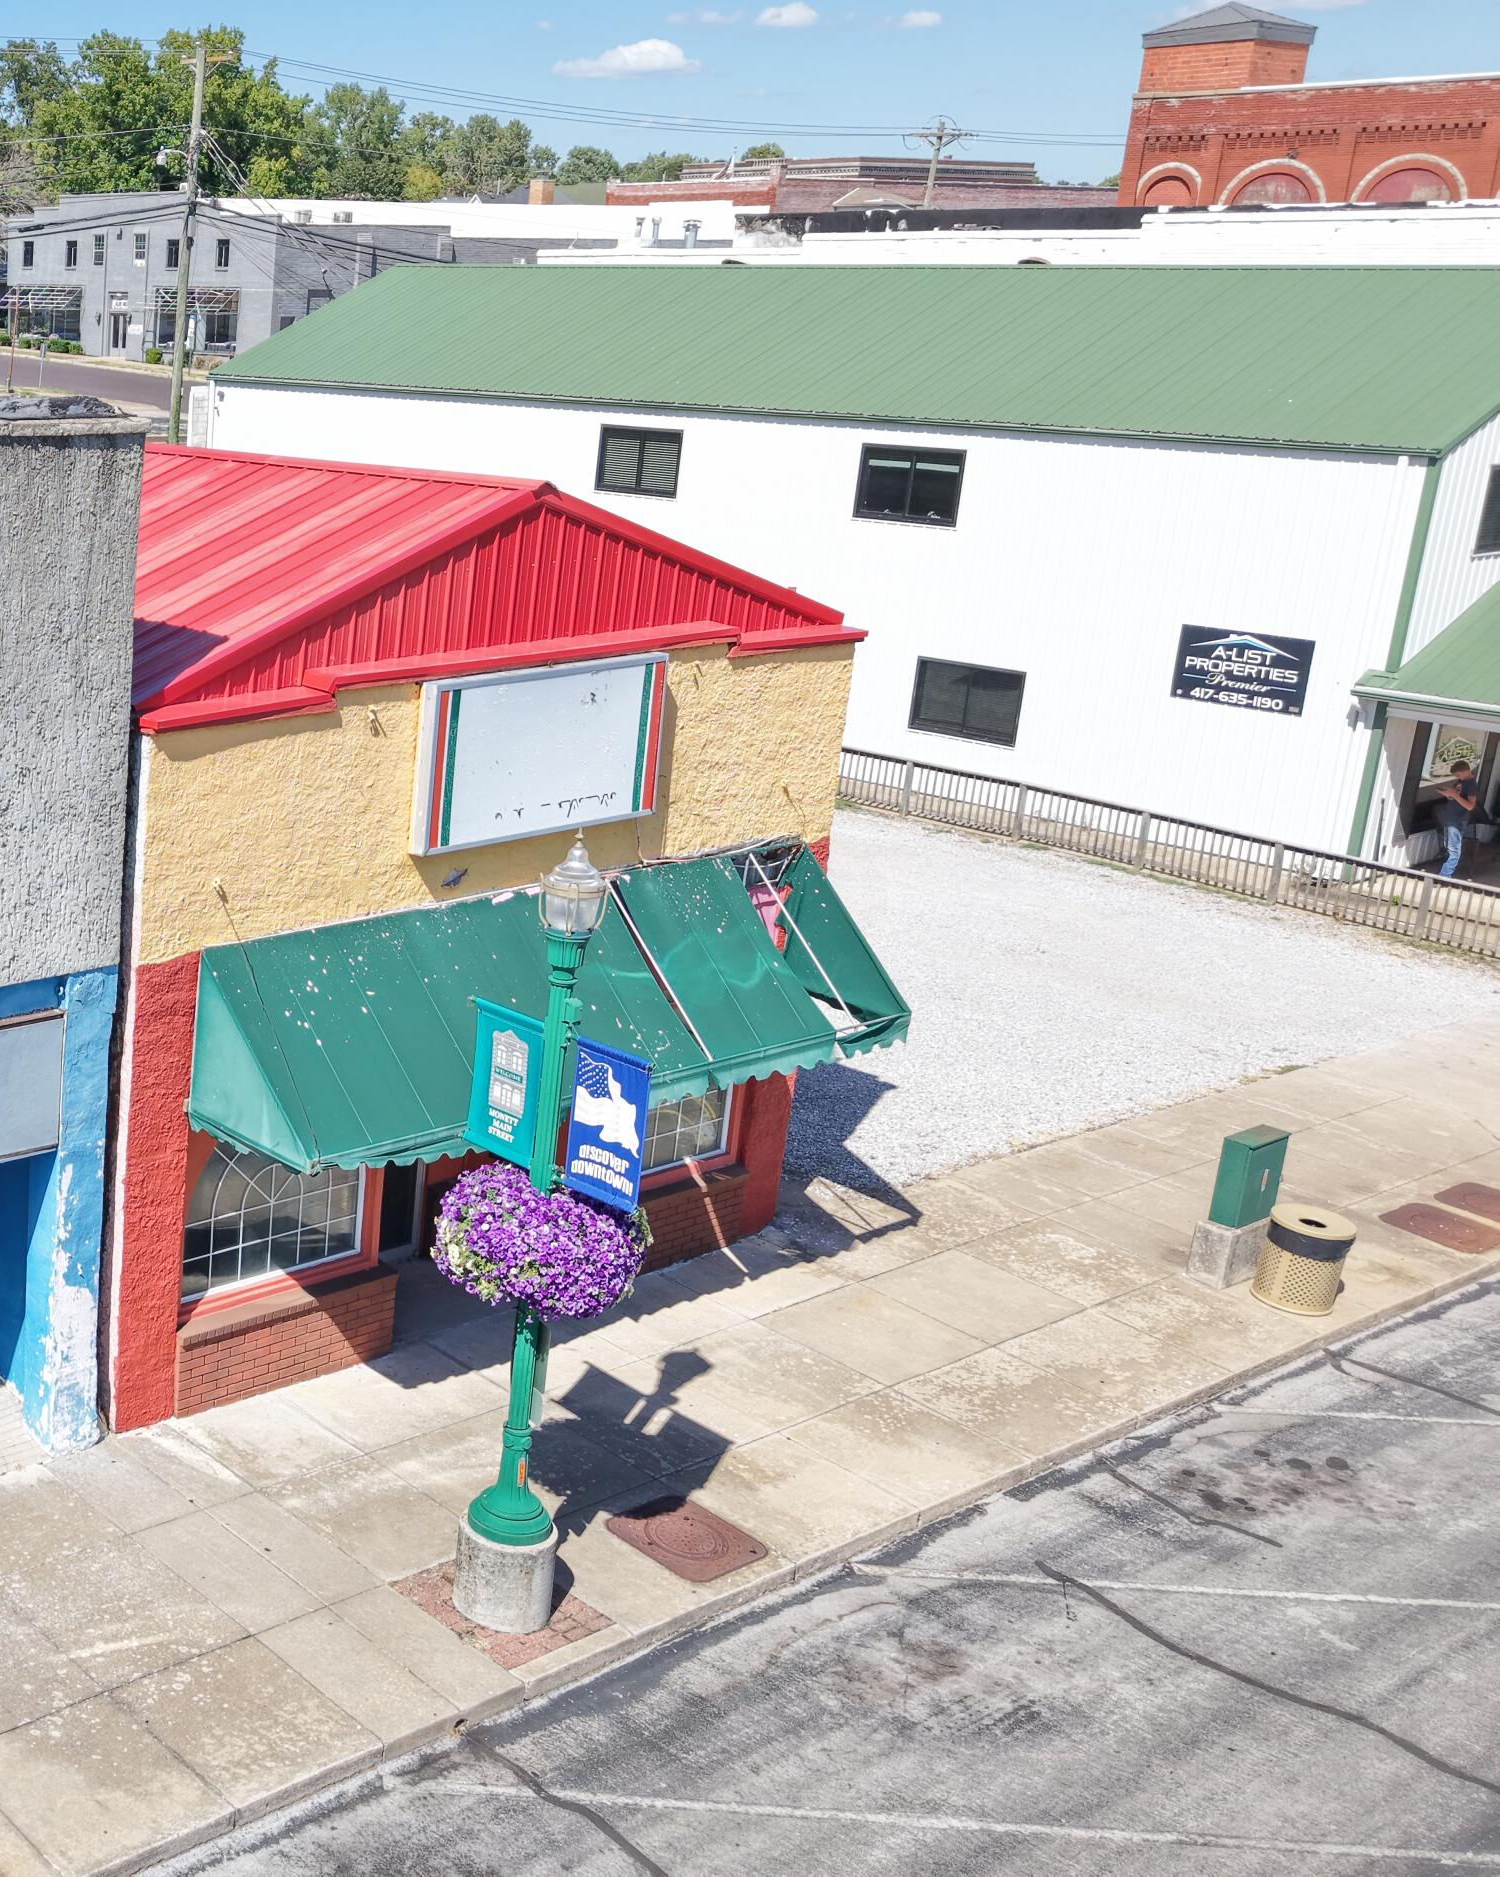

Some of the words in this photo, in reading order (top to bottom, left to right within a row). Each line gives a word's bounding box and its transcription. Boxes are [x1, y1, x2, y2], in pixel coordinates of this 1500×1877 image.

[1211, 646, 1277, 665] A-LIST
[1185, 656, 1299, 683] PROPERTIES
[1205, 672, 1272, 692] Premier
[1190, 687, 1283, 710] 417-635-1190
[495, 1066, 522, 1081] WELCOME
[488, 1108, 519, 1126] MONETT
[492, 1118, 513, 1133] MAIN
[487, 1126, 514, 1143] STREET
[571, 1159, 633, 1197] downtown!
